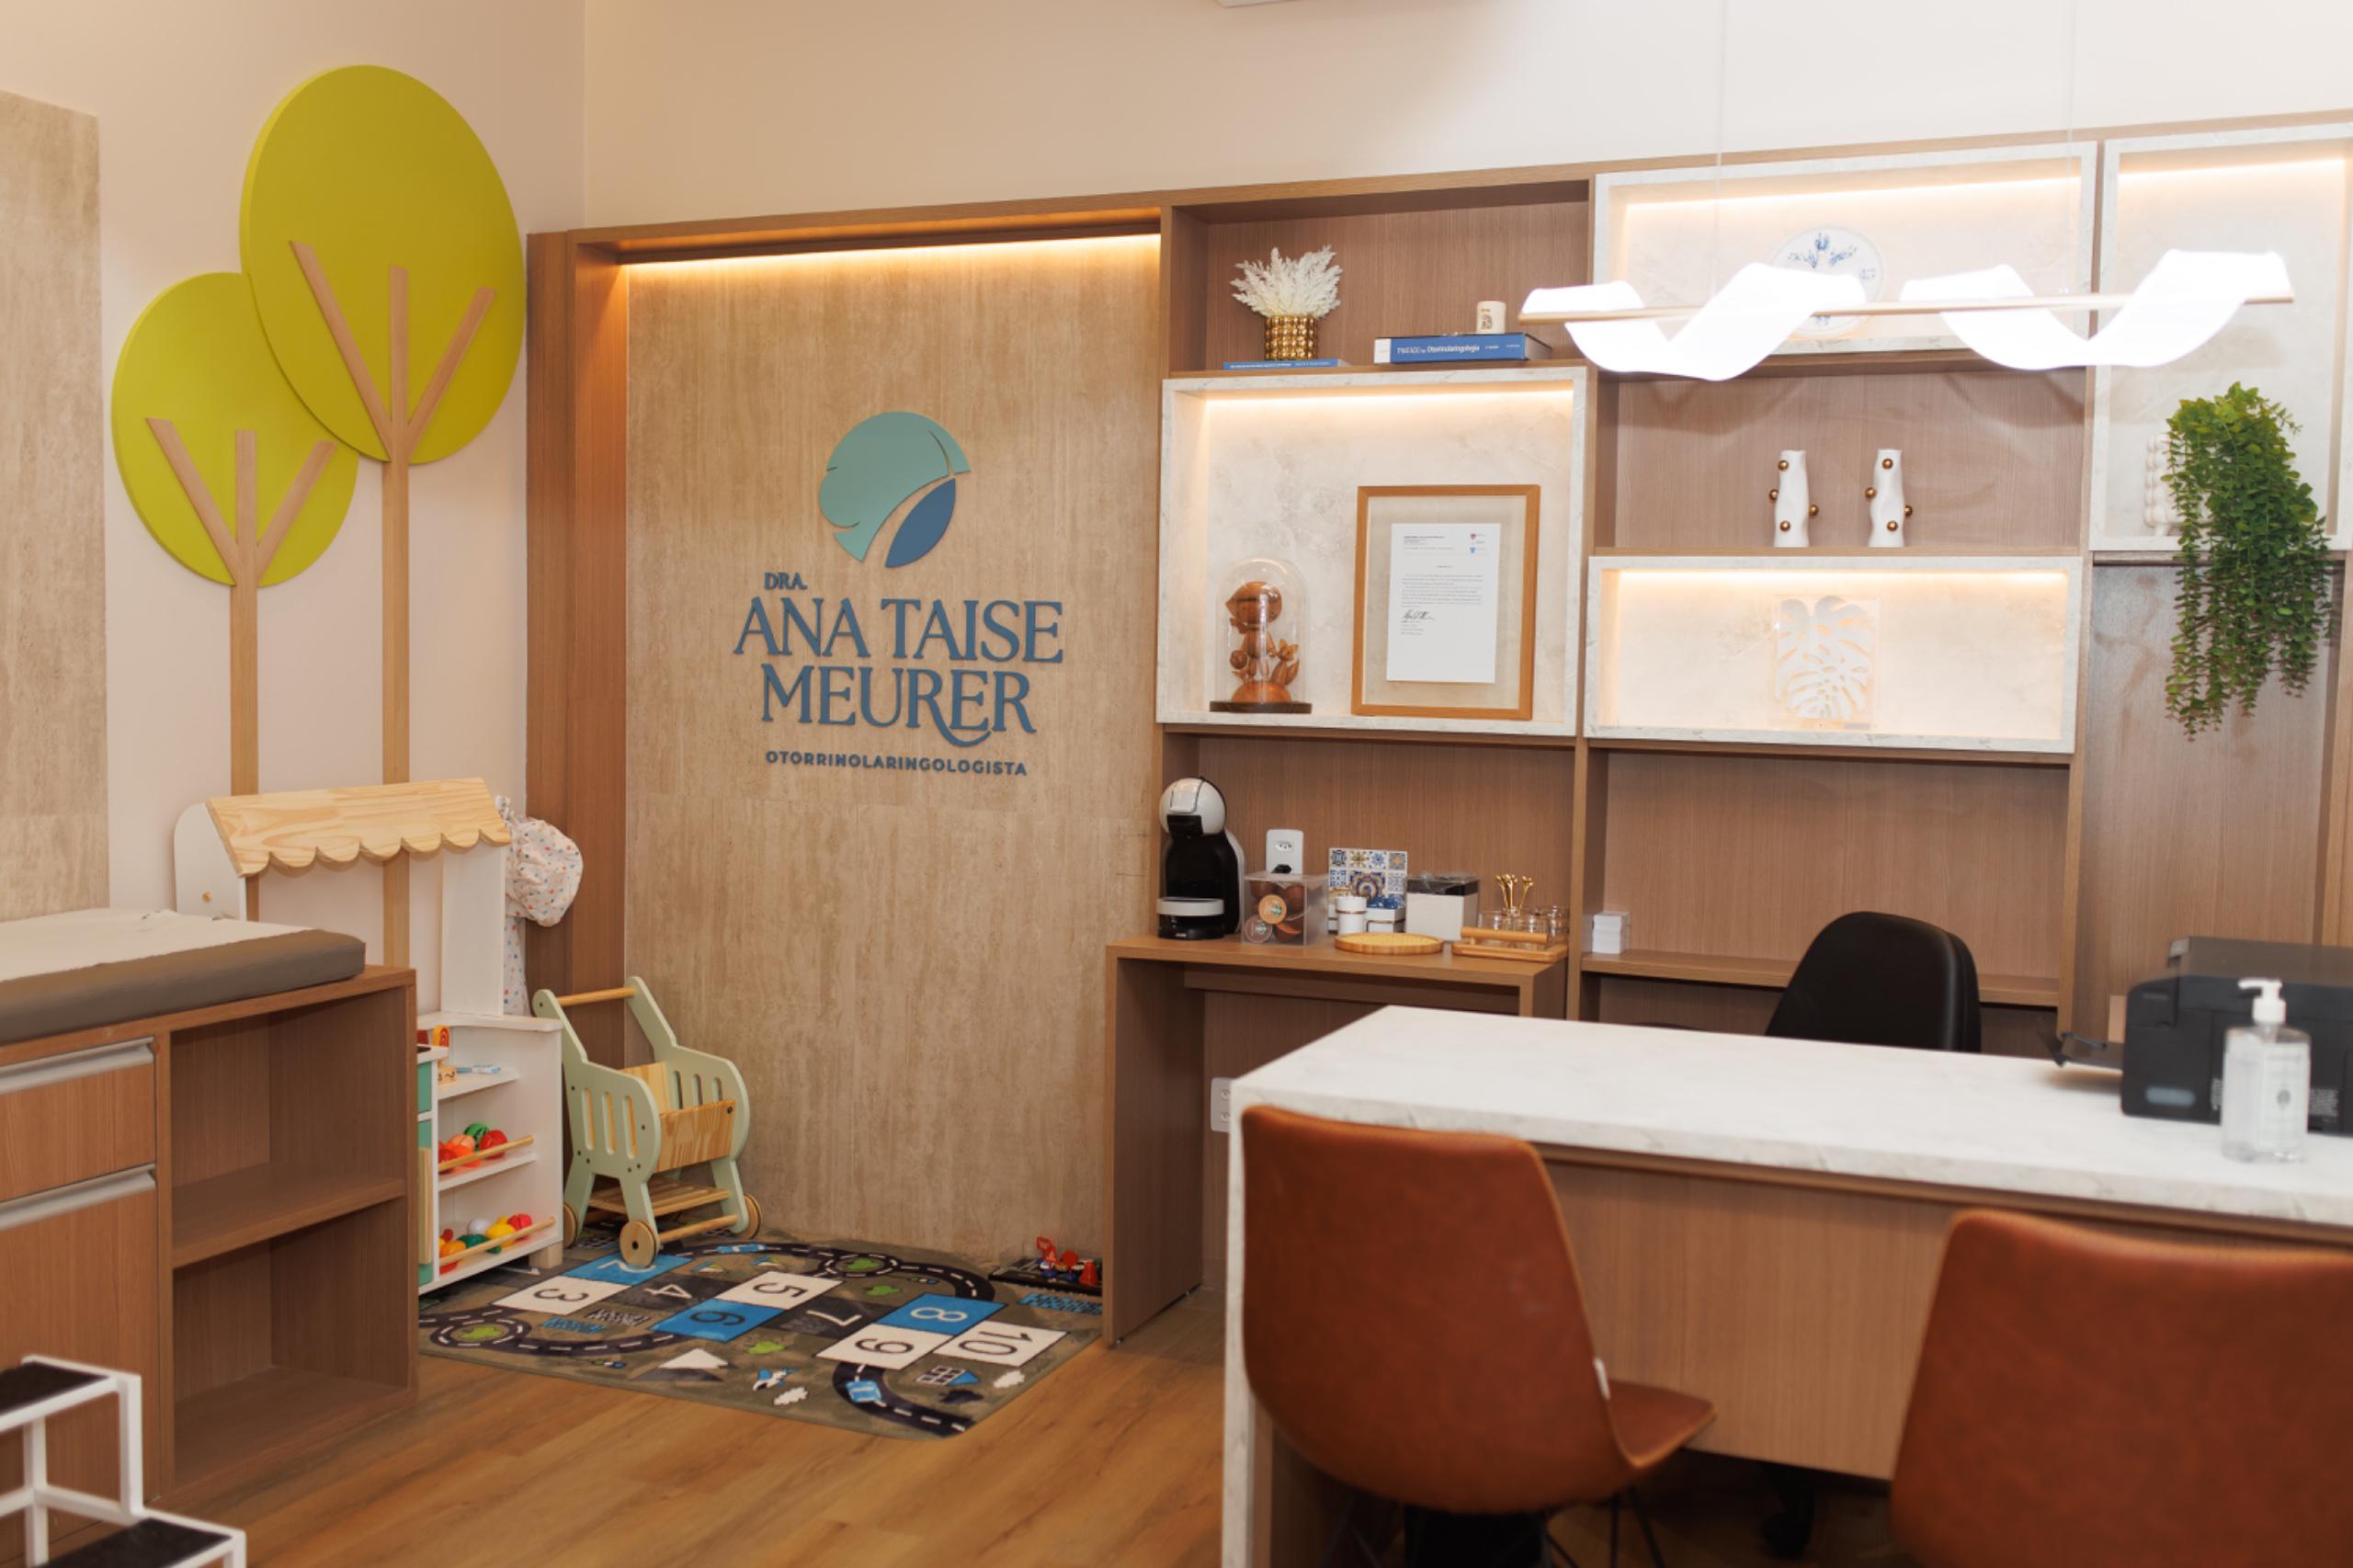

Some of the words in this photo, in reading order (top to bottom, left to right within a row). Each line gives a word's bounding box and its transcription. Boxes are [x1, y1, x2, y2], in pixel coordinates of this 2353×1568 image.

[764, 572, 808, 590] DRA.
[733, 596, 871, 658] ANA
[881, 598, 1063, 664] TAISE
[760, 663, 1038, 748] MEURER
[766, 750, 1028, 776] OTORRINOLARINGOLOGISTA
[533, 1288, 589, 1302] 3
[644, 1284, 692, 1299] 4
[752, 1281, 809, 1298] 5
[690, 1310, 746, 1326] 6
[806, 1310, 862, 1326] 7
[910, 1306, 968, 1323] 8
[854, 1338, 915, 1354] 9
[958, 1330, 1033, 1356] 10
